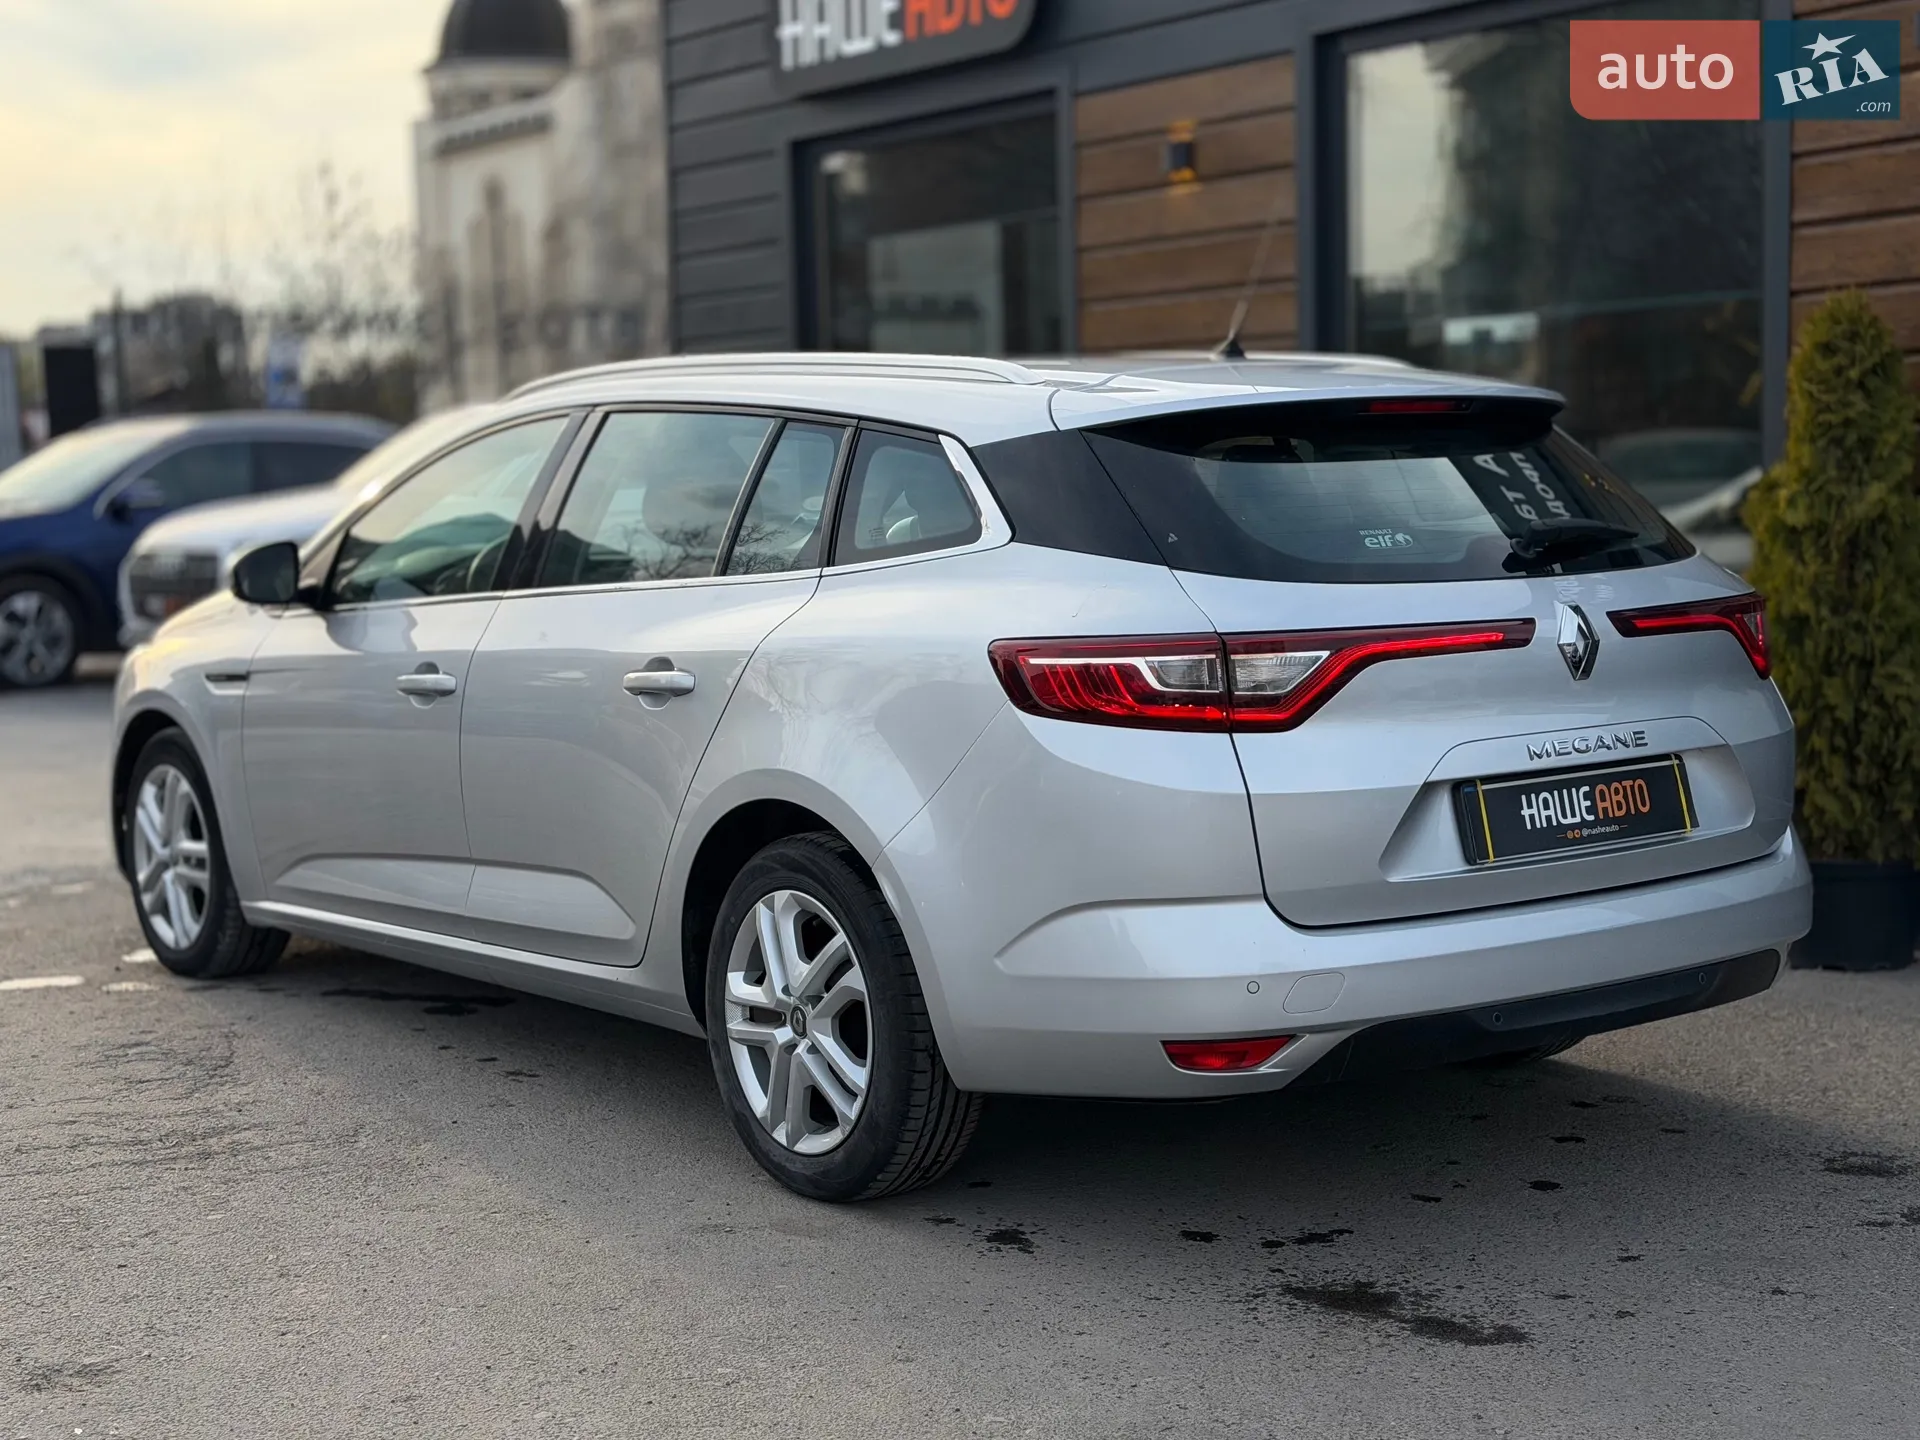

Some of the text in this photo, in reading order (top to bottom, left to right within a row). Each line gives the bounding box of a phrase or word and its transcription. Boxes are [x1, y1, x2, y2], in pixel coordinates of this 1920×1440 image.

[776, 0, 903, 71] НАШЕ
[1364, 534, 1394, 548] elf
[1526, 730, 1649, 761] MEGANE
[1520, 778, 1651, 830] НАШЕ АВТО
[1581, 824, 1620, 838] @nasheauto
